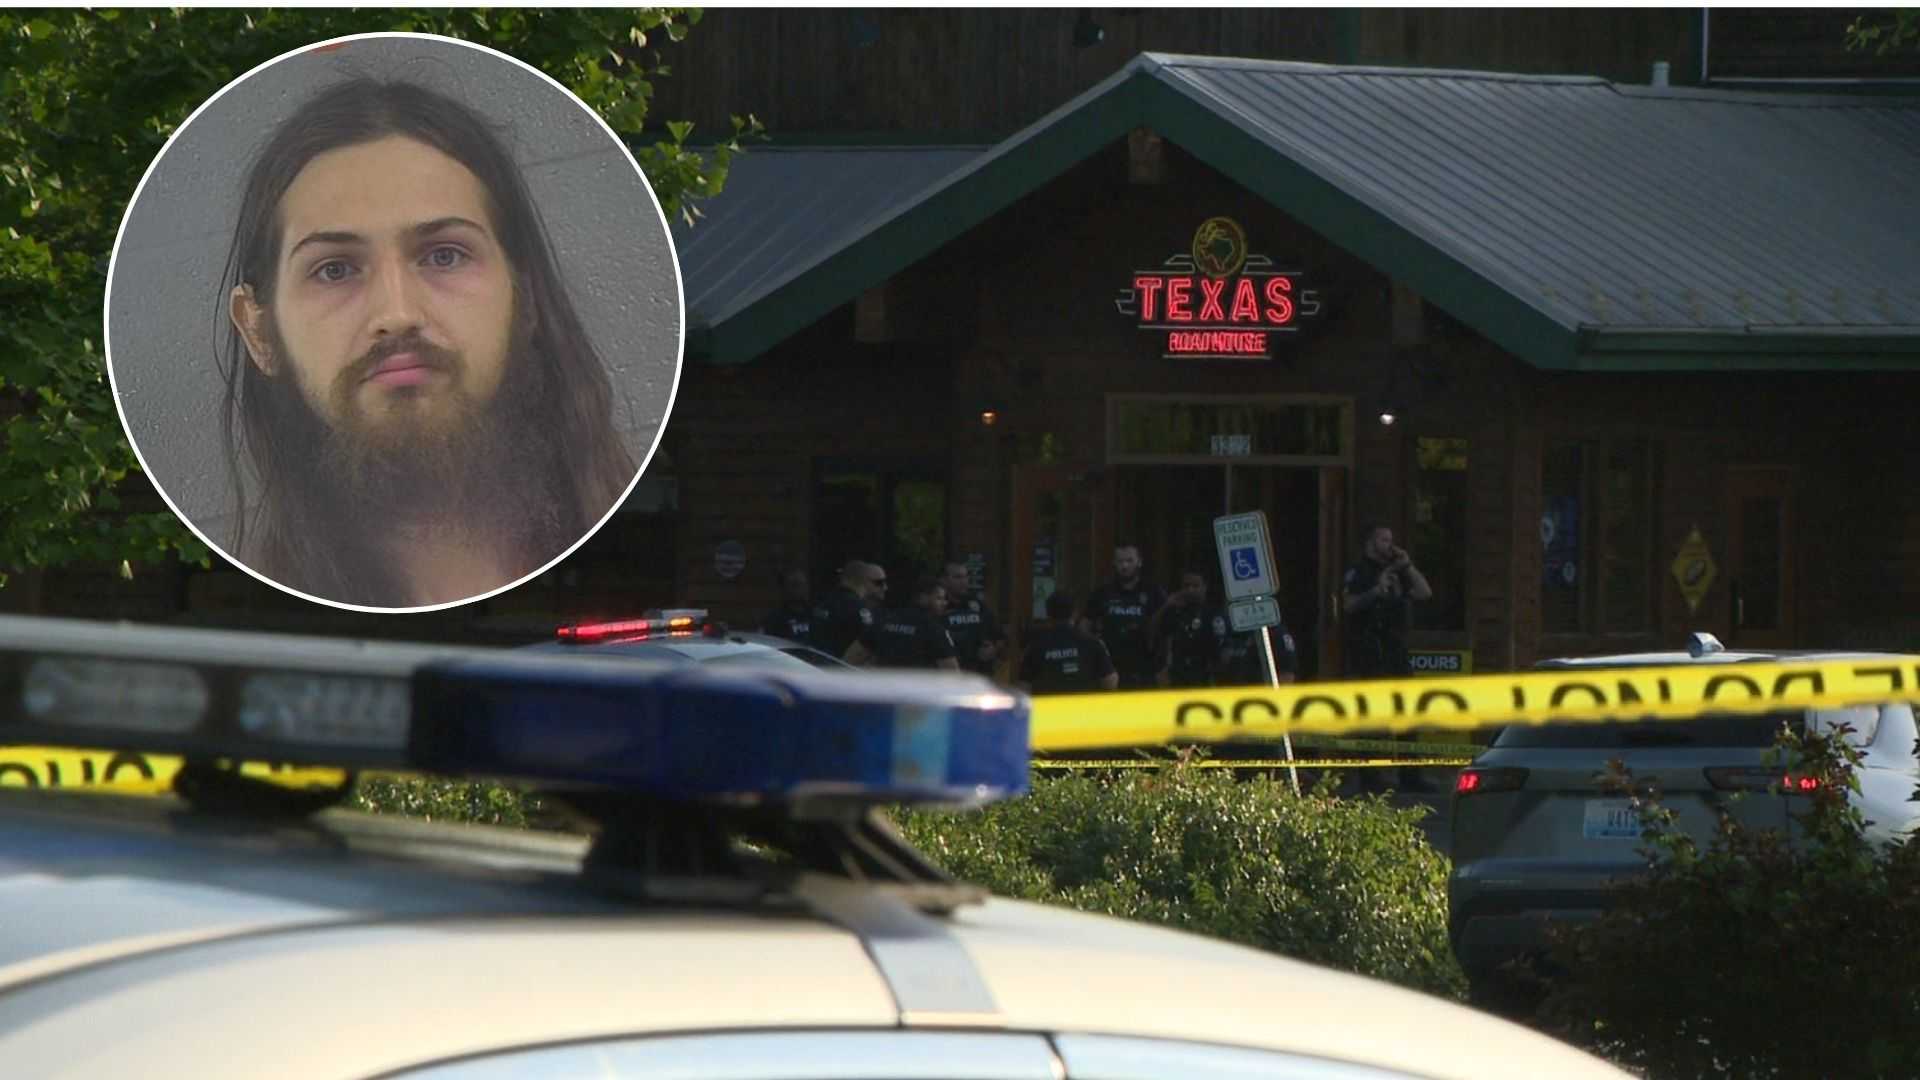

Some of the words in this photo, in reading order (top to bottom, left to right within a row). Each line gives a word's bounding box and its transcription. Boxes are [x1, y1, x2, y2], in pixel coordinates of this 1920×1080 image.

[1135, 277, 1295, 324] TEXAS
[948, 613, 981, 626] POLICE
[1044, 647, 1080, 661] POLICE
[1408, 655, 1459, 670] HOURS
